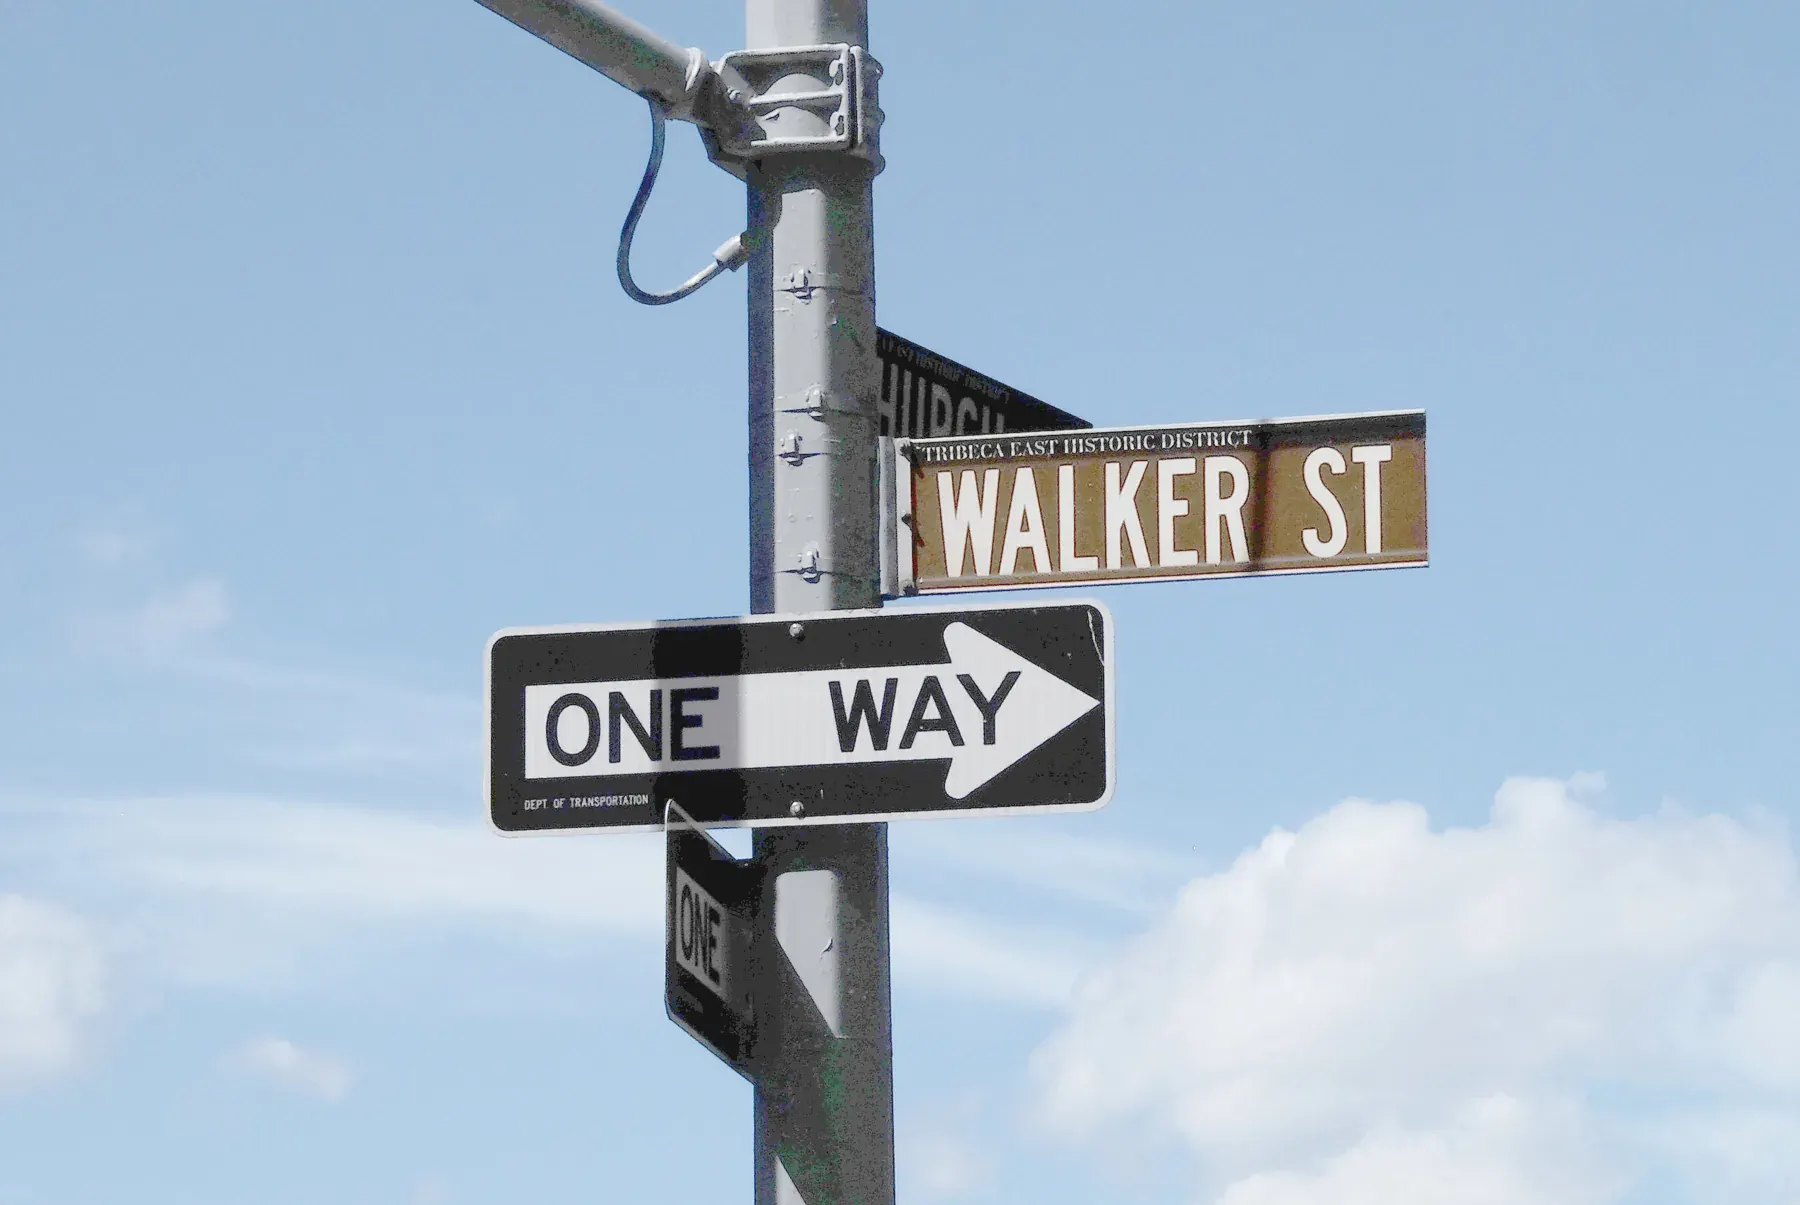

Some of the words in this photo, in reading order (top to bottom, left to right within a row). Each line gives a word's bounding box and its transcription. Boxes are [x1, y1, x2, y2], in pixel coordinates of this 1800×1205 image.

[924, 443, 1001, 462] TRIBECA
[1010, 440, 1058, 457] EAST
[1063, 434, 1155, 454] HISTORIC
[1161, 429, 1252, 449] DISTRICT
[936, 456, 1252, 578] WALKER
[1302, 444, 1393, 559] ST
[545, 686, 720, 767] ONE
[828, 670, 1022, 753] WAY
[553, 798, 566, 809] OF
[569, 794, 649, 808] TRANSPORTATION
[680, 883, 721, 987] ONE
